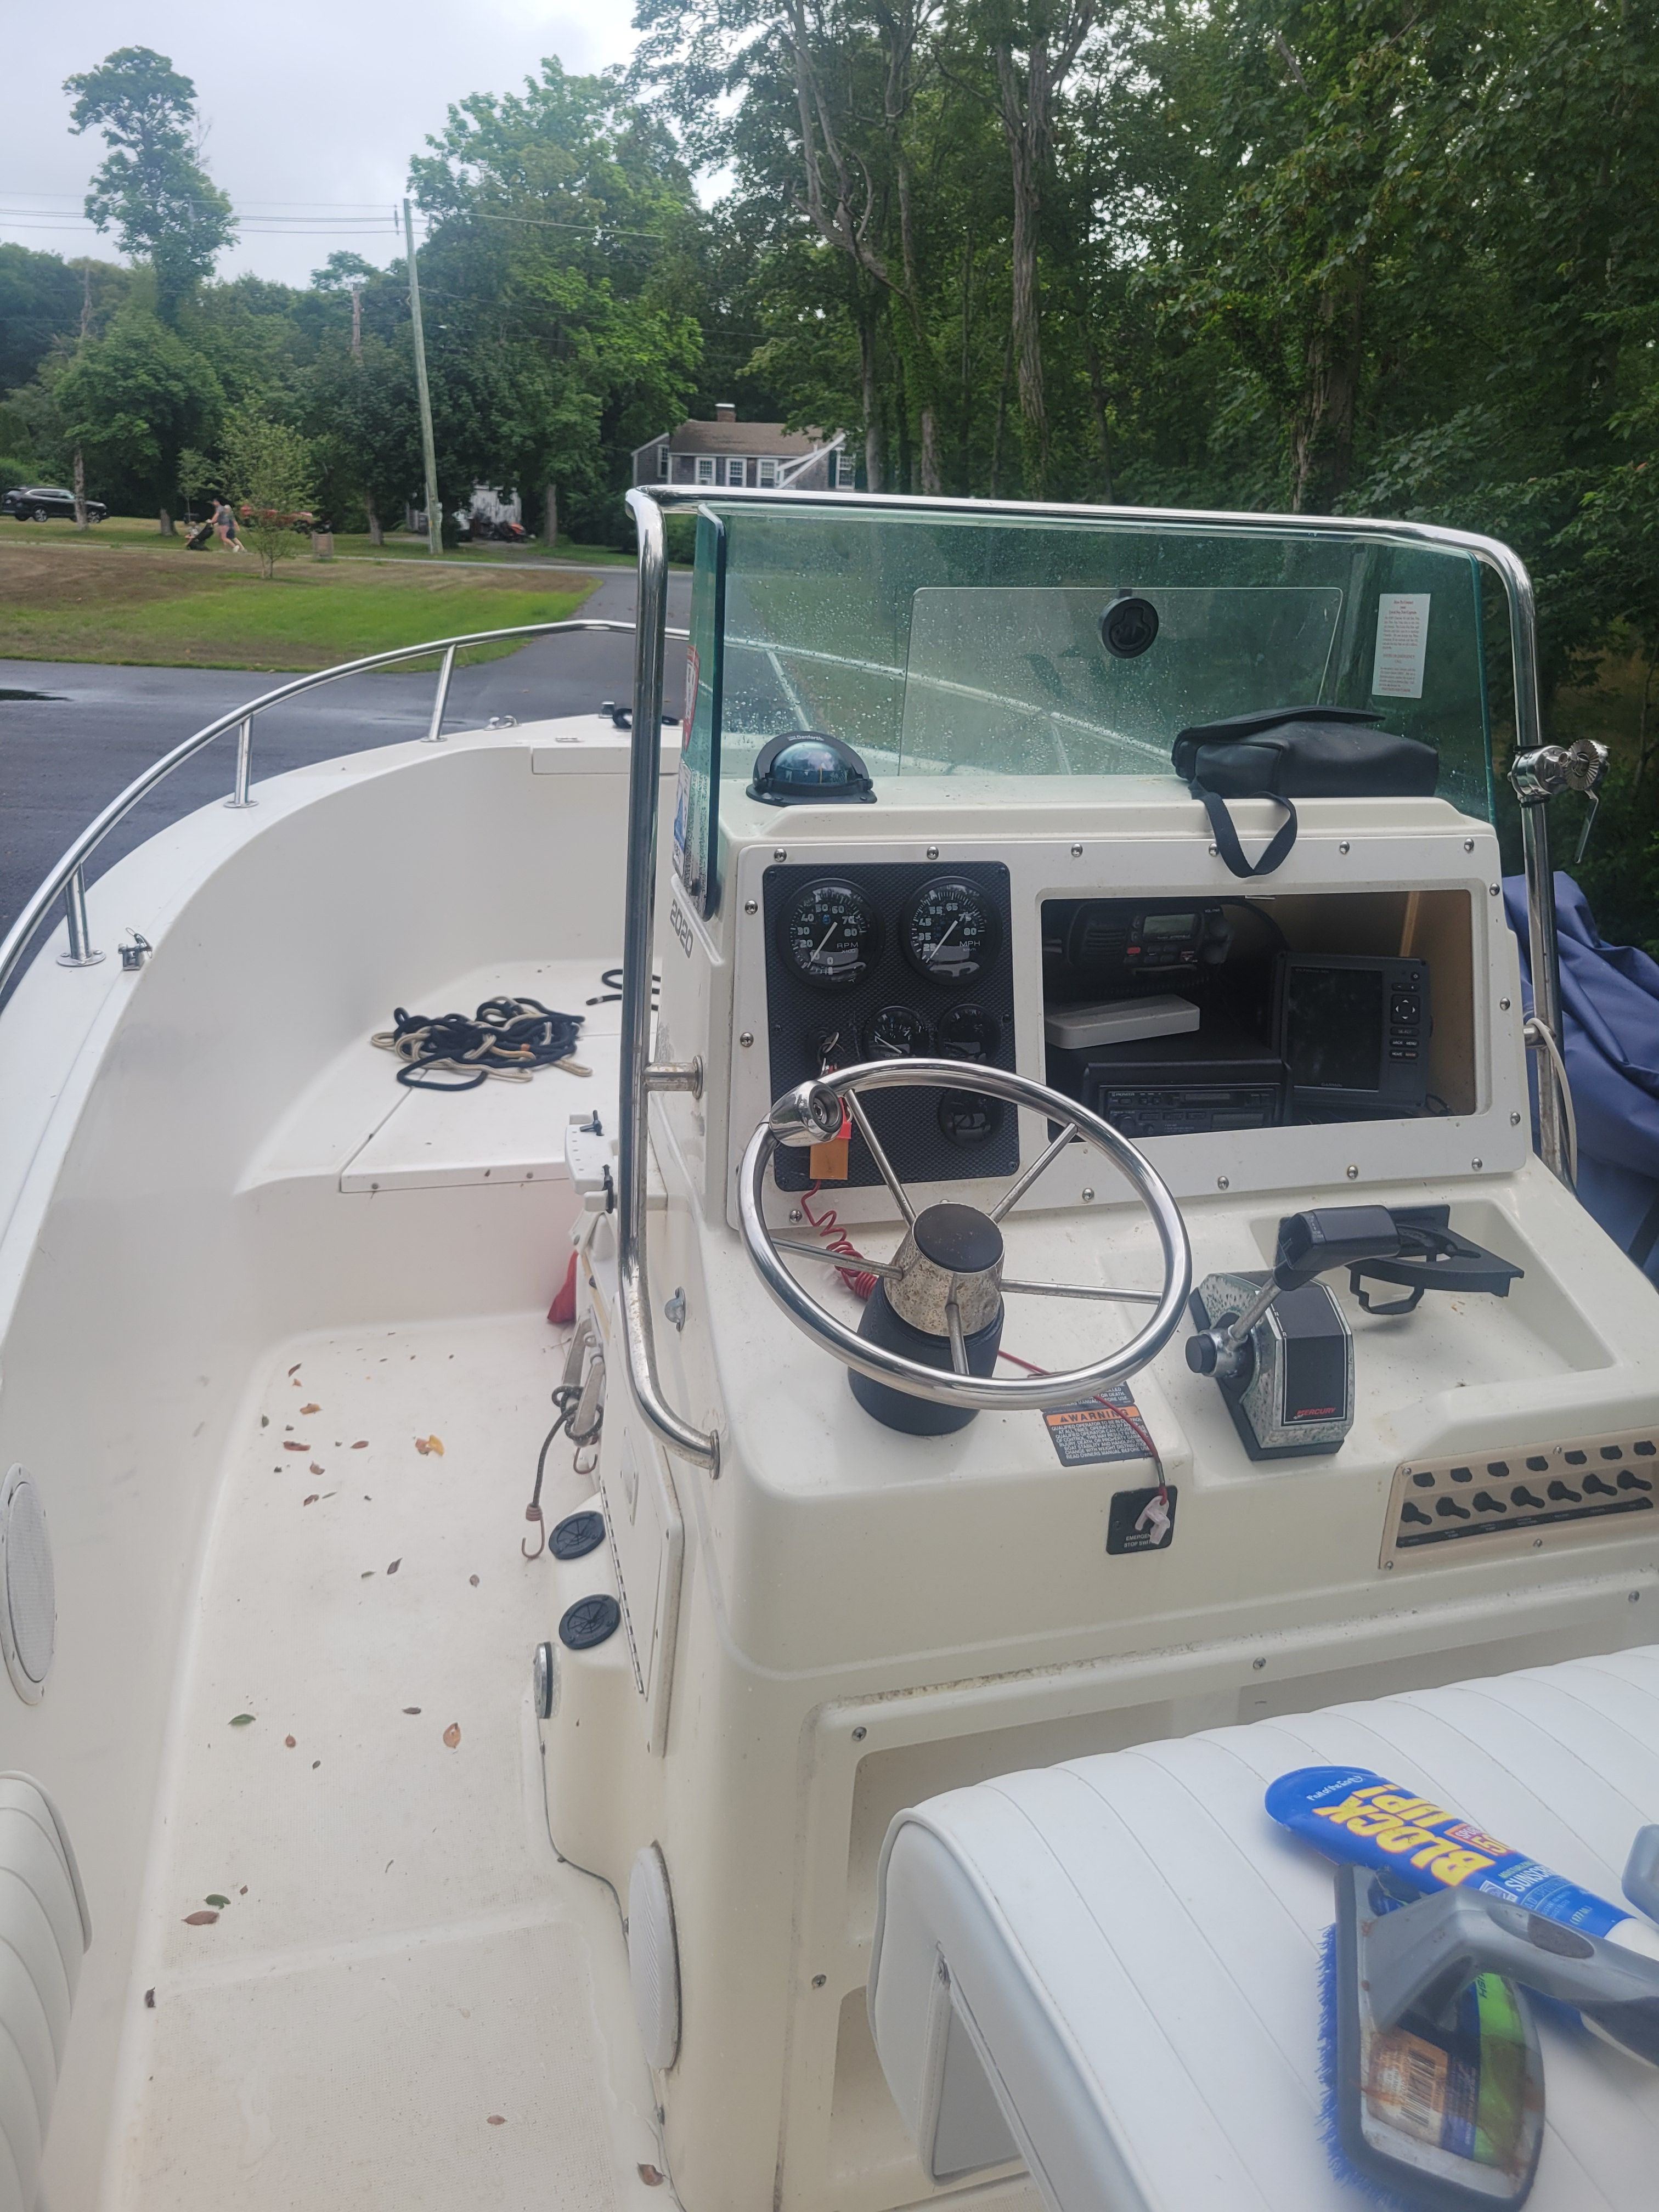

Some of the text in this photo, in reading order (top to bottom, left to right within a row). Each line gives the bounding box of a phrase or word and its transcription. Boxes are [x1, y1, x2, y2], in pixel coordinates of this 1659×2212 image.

[815, 904, 828, 912] 50
[832, 906, 845, 914] 60
[929, 906, 943, 915] 55
[946, 902, 958, 911] 65
[801, 913, 814, 922] 40
[842, 916, 855, 924] 70
[670, 898, 694, 958] 2020
[797, 927, 810, 935] 30
[844, 928, 857, 936] 80
[799, 939, 813, 948] 20
[923, 943, 937, 951] 25
[810, 952, 820, 960] 10
[827, 957, 834, 965] 0
[1068, 1408, 1129, 1422] WARNING
[1296, 1407, 1335, 1415] MERCURY
[1306, 1791, 1327, 1801] Fruit
[1336, 1775, 1363, 1786] Earth
[1312, 1795, 1497, 1886] BLOCK
[1504, 1865, 1553, 1892] SUNSCR
